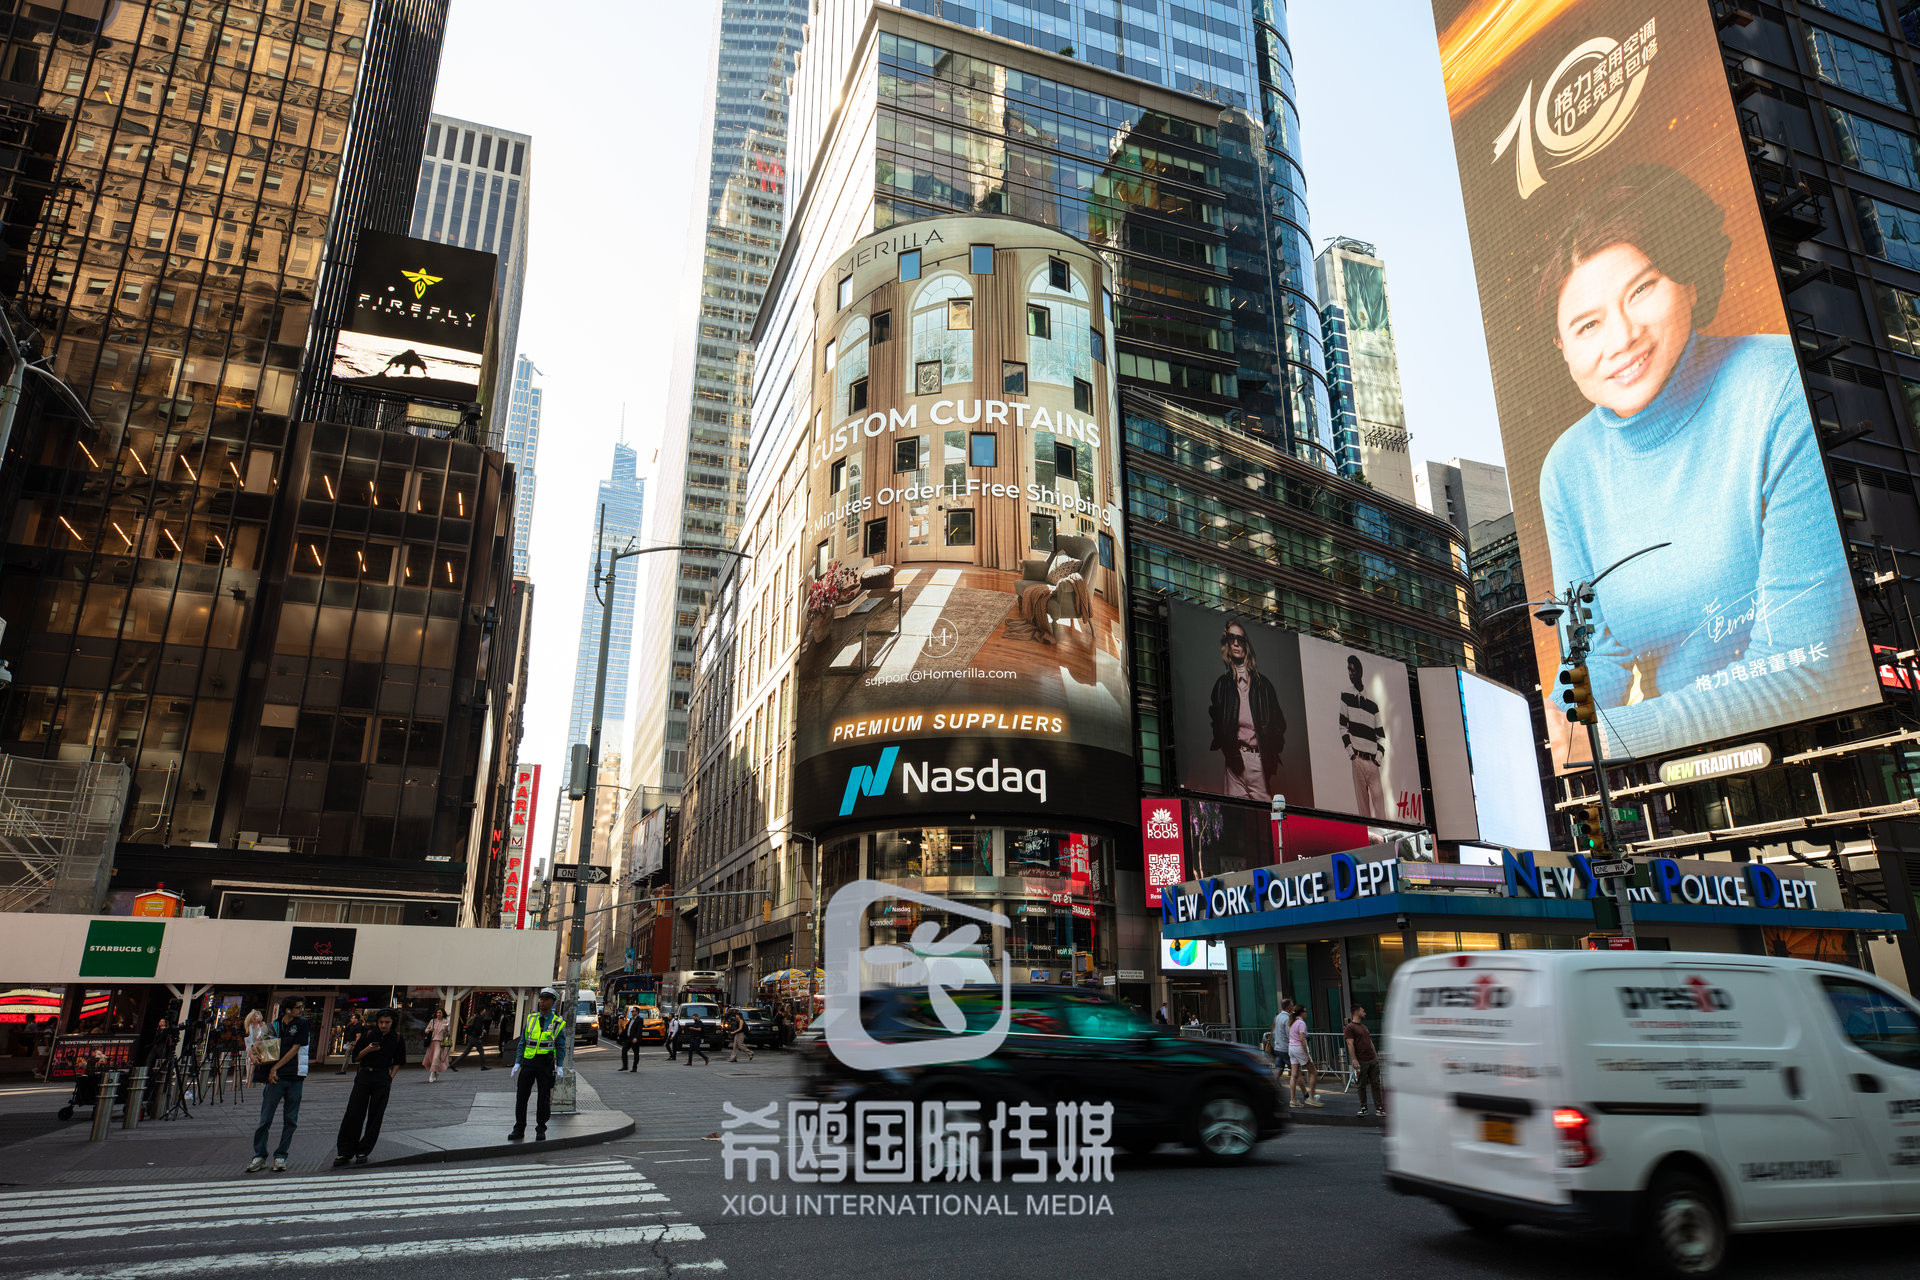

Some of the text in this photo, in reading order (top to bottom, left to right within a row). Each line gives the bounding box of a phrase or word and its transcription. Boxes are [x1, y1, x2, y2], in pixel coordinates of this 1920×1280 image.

[1554, 17, 1656, 119] 格力家用空调
[358, 303, 473, 328] AEROSPACE
[359, 293, 476, 321] FIREFLY
[812, 399, 1102, 470] CUSTOM CURTAINS
[814, 496, 872, 536] Minutes
[877, 483, 945, 506] Order
[966, 478, 1020, 499] Free
[1027, 483, 1111, 526] Shipping
[865, 668, 1017, 687] support@Homerilla.com
[1695, 640, 1830, 693] 格力电器董事长
[833, 713, 1063, 742] PREMIUM SUPPLIERS
[902, 759, 1047, 804] Nasdaq
[513, 772, 531, 826] PARK
[1397, 791, 1422, 822] H&M
[1147, 823, 1178, 832] LOTUS
[1147, 831, 1179, 839] ROOM
[561, 869, 577, 877] ONE
[1502, 848, 1577, 899] NEW
[1652, 858, 1750, 907] POLICE
[1746, 864, 1818, 909] DEPT
[1594, 863, 1628, 873] ONE WAY
[503, 857, 521, 913] PARK
[1162, 853, 1400, 925] NEW YORK POLICE DEPT
[1026, 906, 1047, 914] Nasdaq
[89, 945, 142, 953] STARBUCKS
